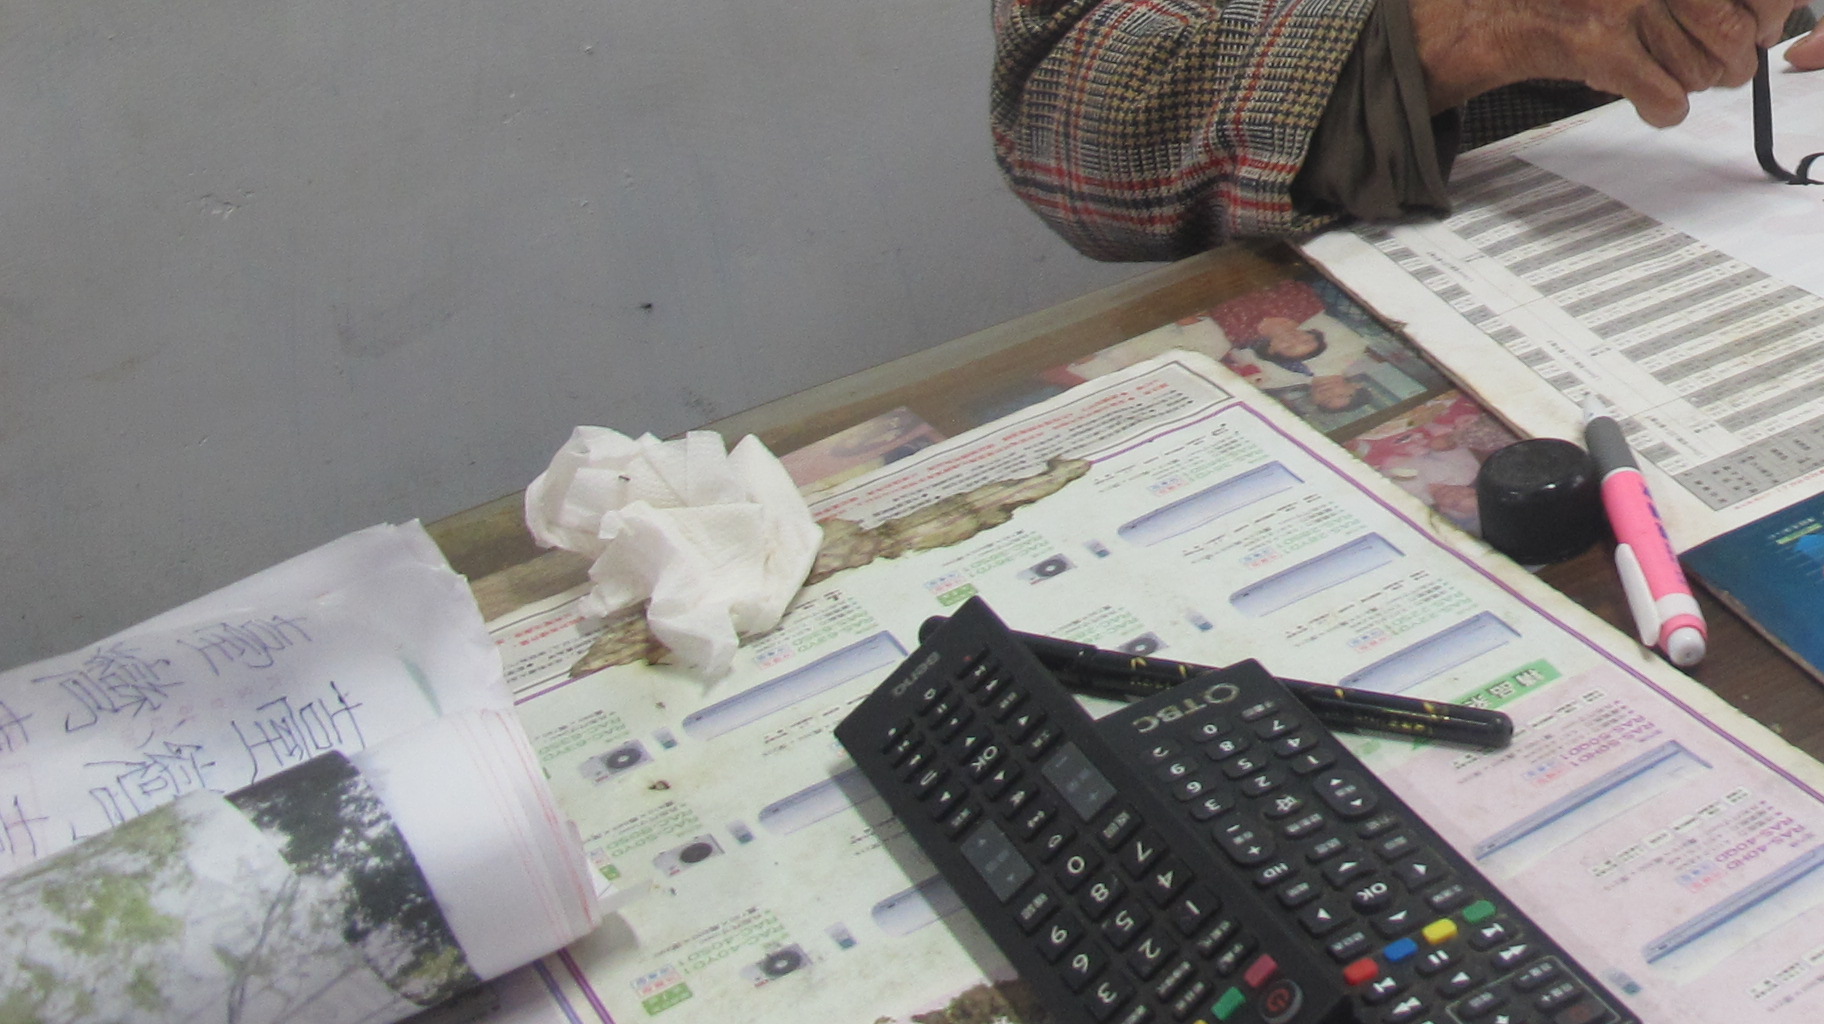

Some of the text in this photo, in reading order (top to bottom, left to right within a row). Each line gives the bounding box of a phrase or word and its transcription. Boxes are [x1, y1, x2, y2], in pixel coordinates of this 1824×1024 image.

[1203, 723, 1218, 735] 0
[1271, 719, 1285, 733] 7
[1219, 740, 1235, 752] 8
[1287, 737, 1301, 749] 4
[971, 745, 998, 772] OK
[1238, 758, 1253, 770] 5
[1307, 754, 1320, 765] 1
[1169, 763, 1186, 775] 9
[1186, 781, 1202, 793] 6
[1255, 775, 1271, 788] 2
[1204, 799, 1221, 812] 3
[1135, 840, 1153, 862] 7
[1067, 856, 1085, 875] 0
[1262, 862, 1289, 879] HD
[1157, 870, 1175, 889] 4
[1090, 882, 1110, 903] 8
[1356, 882, 1388, 902] OK
[1185, 898, 1200, 916] 1
[1115, 909, 1135, 931] 5
[1050, 924, 1068, 944] 9
[1138, 938, 1161, 958] 2
[1071, 953, 1089, 974] 6
[1097, 982, 1118, 1004] 3
